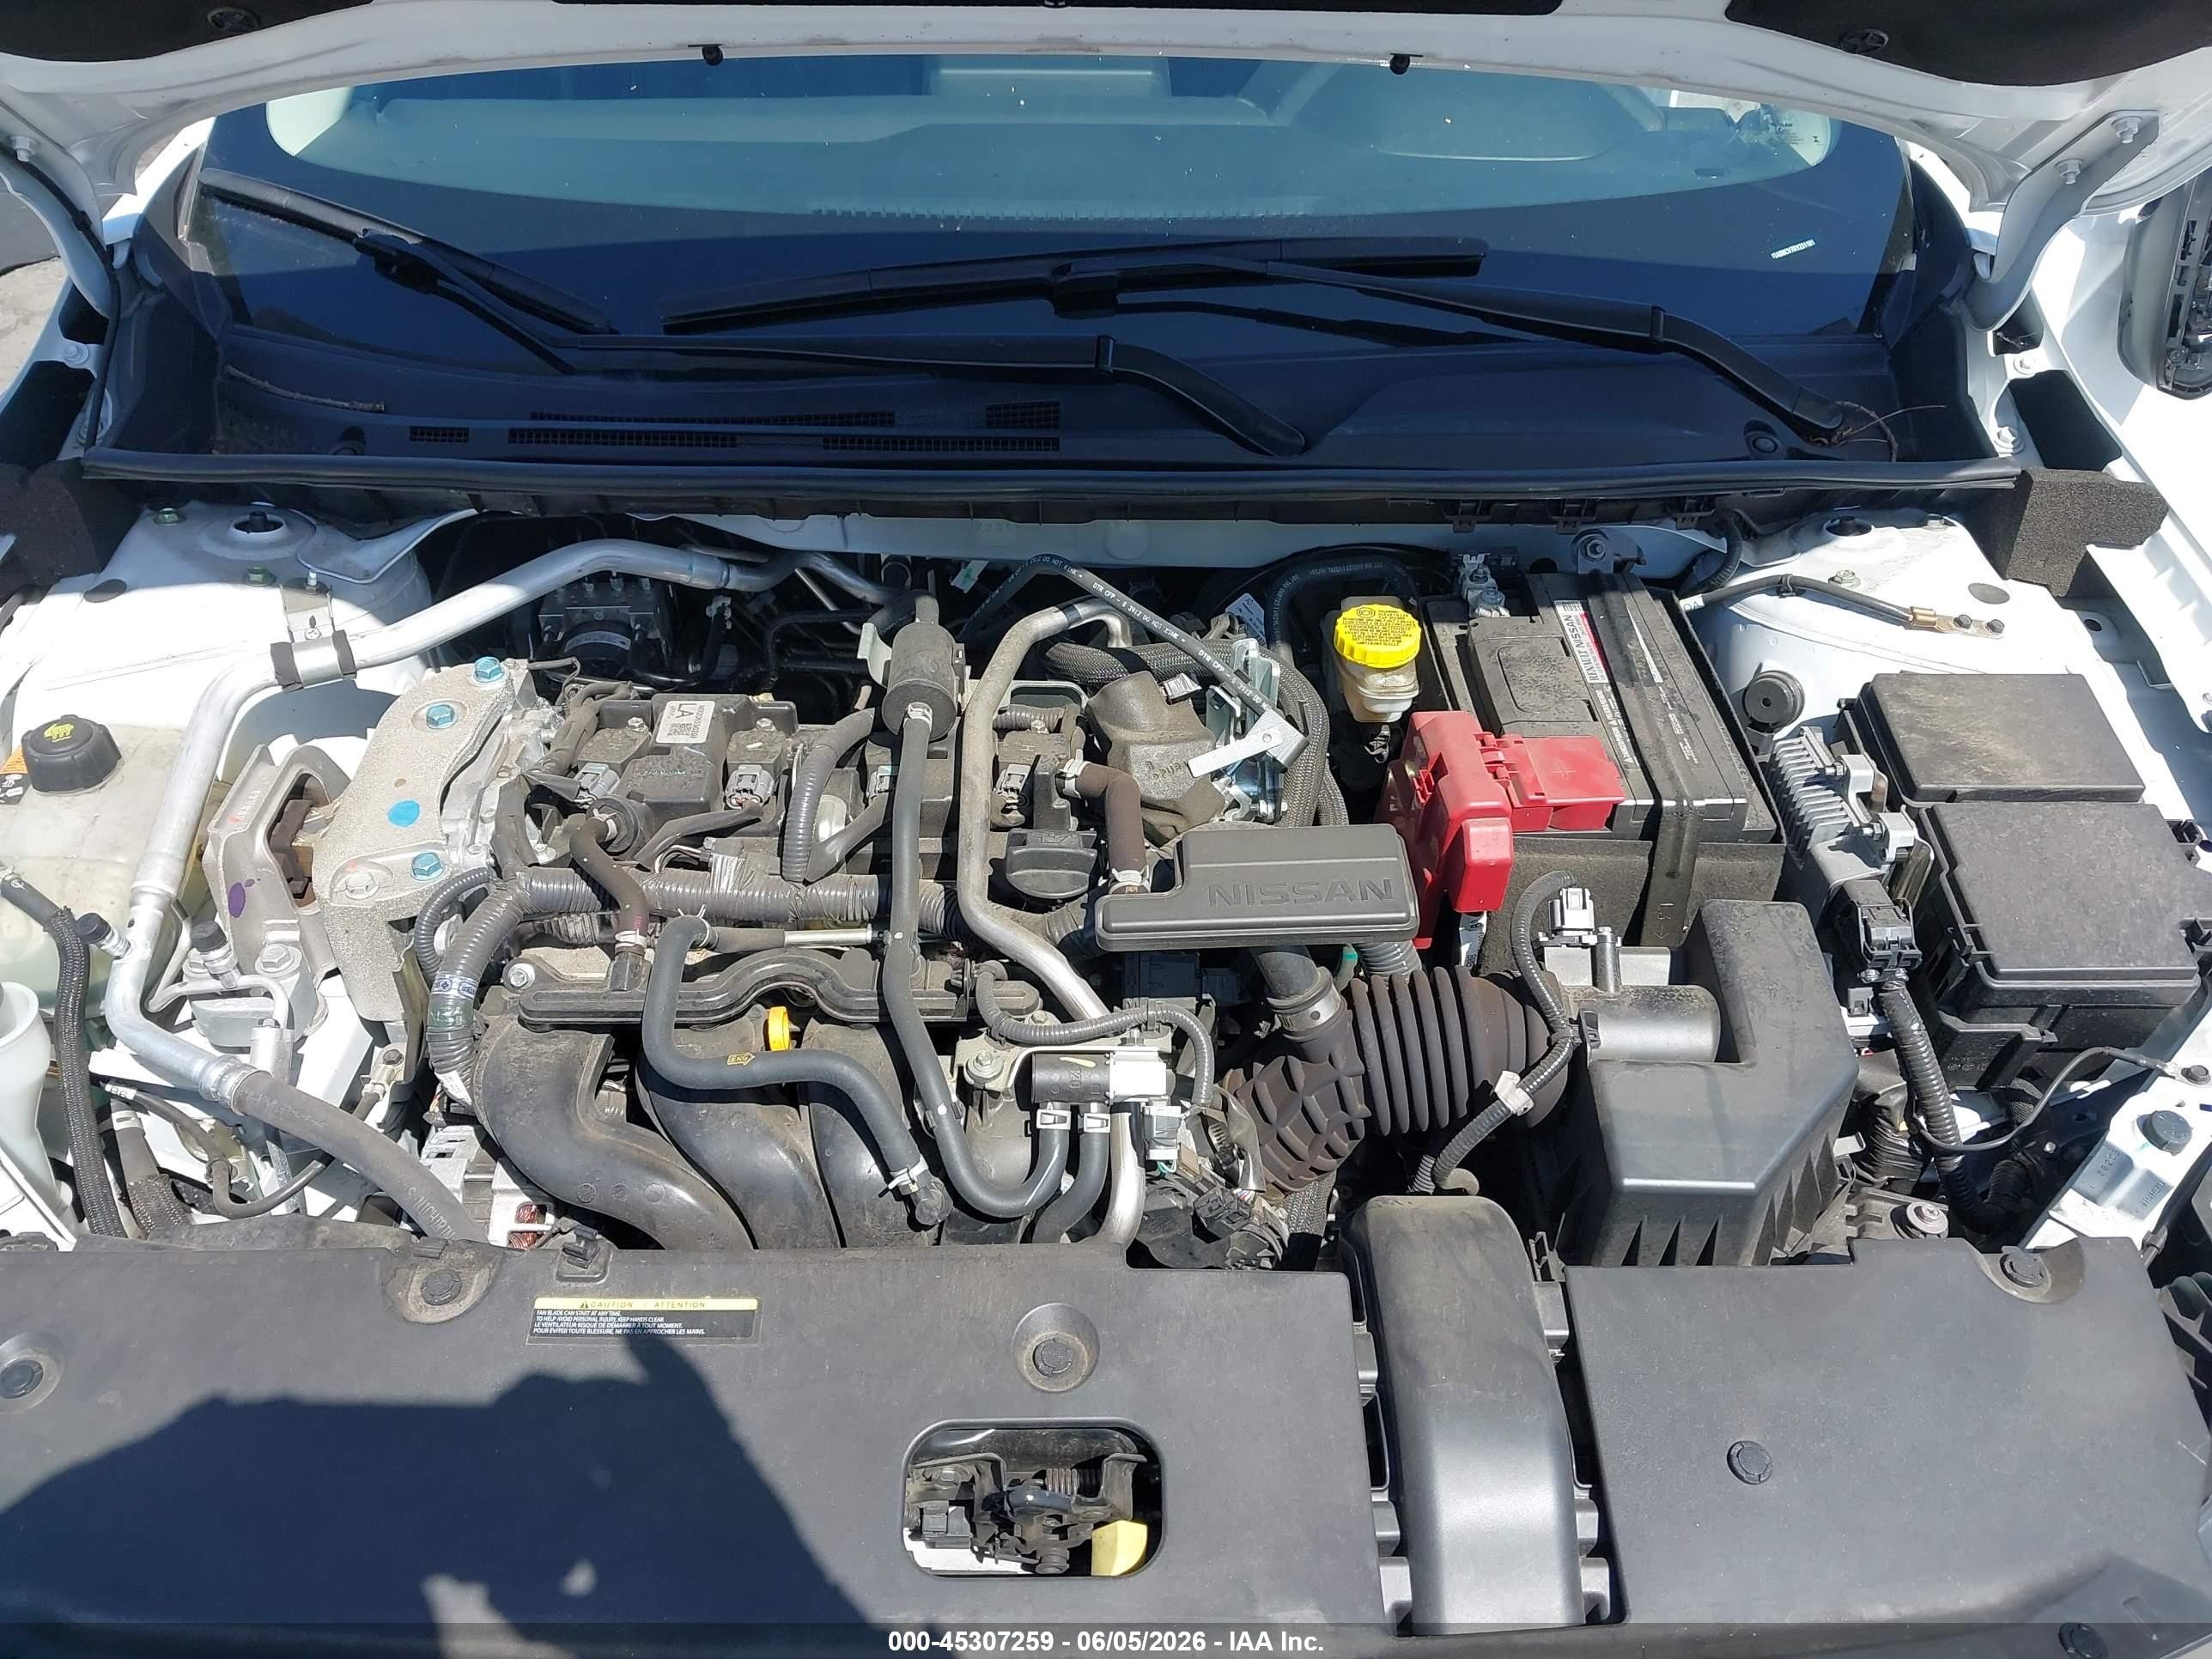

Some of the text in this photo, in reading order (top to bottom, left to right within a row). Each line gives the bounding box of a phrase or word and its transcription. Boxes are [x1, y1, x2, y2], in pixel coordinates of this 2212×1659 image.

[1562, 614, 1584, 648] NISSAN
[1577, 648, 1600, 682] RENAULT
[675, 702, 697, 719] LA
[1207, 878, 1395, 908] NISSAN
